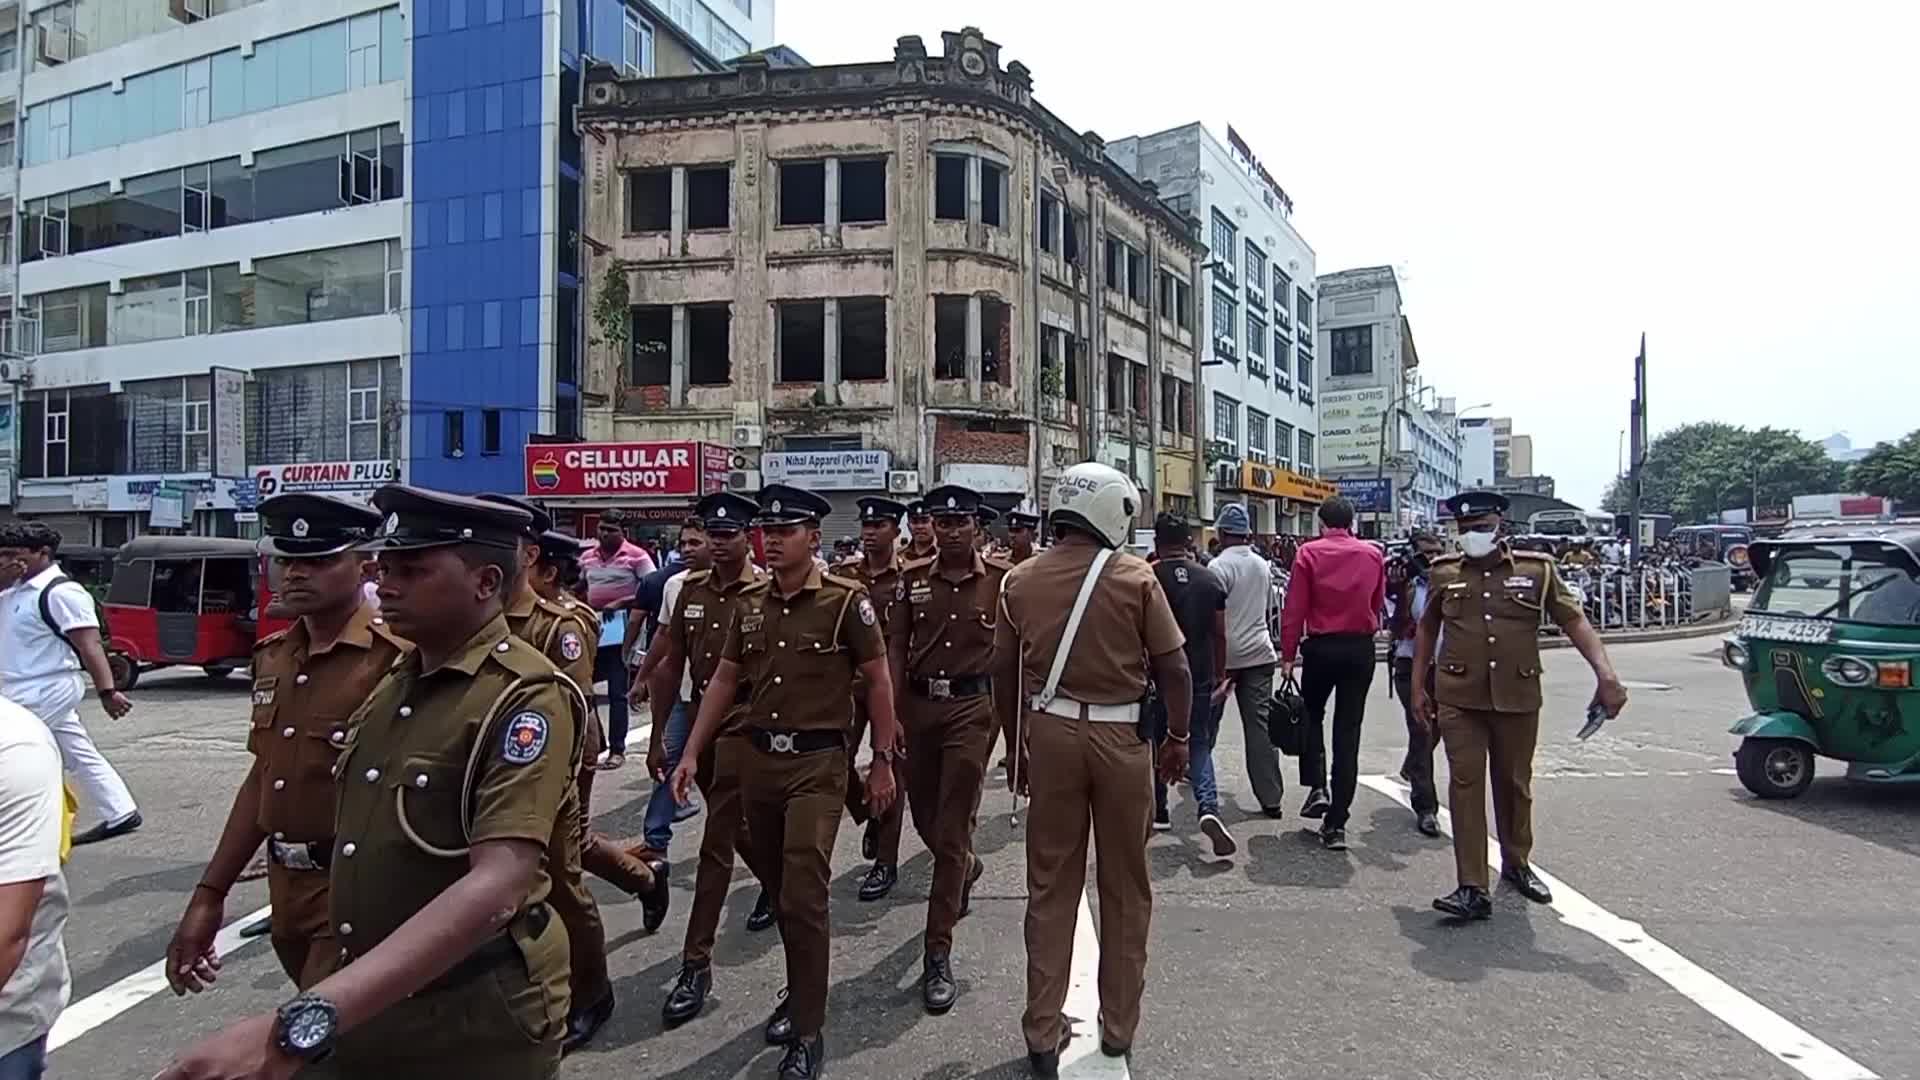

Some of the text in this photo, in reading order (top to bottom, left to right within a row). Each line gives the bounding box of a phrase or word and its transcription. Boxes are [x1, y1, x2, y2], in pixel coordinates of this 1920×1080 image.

[1357, 390, 1384, 401] ORIS
[1322, 428, 1351, 437] CASIO
[565, 449, 689, 469] CELLULAR
[785, 453, 879, 468] Nihal Apparel (Pvt) Ltd
[281, 463, 392, 482] CURTAIN PLUS
[583, 471, 668, 489] HOTSPOT
[1788, 623, 1828, 638] 4157
